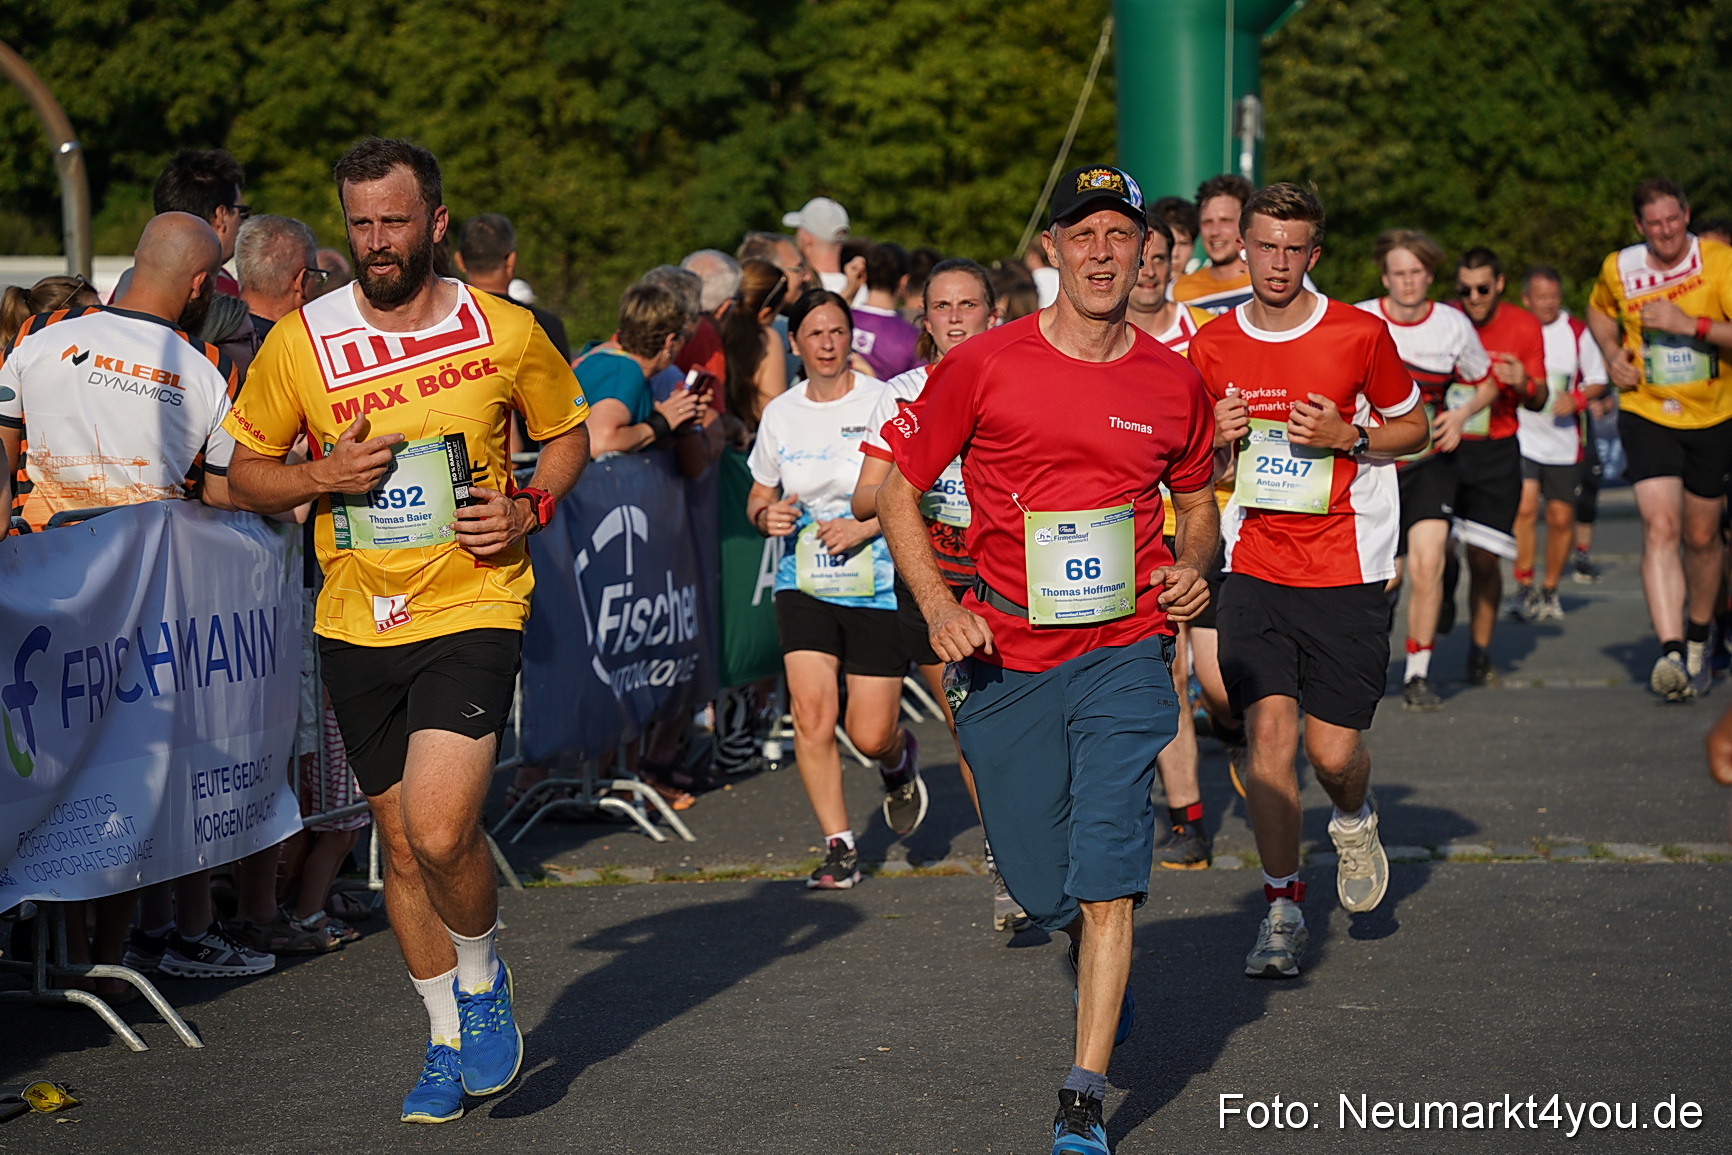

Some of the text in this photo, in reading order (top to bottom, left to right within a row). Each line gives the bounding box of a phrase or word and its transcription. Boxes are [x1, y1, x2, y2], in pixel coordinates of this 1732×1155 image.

[94, 354, 186, 391] KLEBL
[88, 371, 184, 407] DYNAMICS
[331, 357, 499, 424] MAX BÖGL
[1240, 387, 1287, 401] Sparkasse
[1248, 401, 1296, 413] eumarkt-P
[889, 417, 914, 439] 026
[1108, 416, 1153, 435] Thomas
[446, 441, 456, 469] RABATT
[1256, 456, 1313, 478] 2547
[1256, 478, 1281, 487] Anton
[369, 512, 433, 524] Thomas Baier
[1053, 532, 1089, 542] Firmenlauf
[1065, 557, 1102, 581] 66
[1041, 581, 1126, 597] Thomas Hoffmann
[191, 766, 231, 801] HEUTE
[49, 793, 118, 826] LOGISTICS
[194, 805, 245, 845] MORGEN
[17, 825, 98, 859] CORPORATE
[94, 816, 137, 842] PRINT
[24, 838, 154, 883] CORPORATE SIGNAGE
